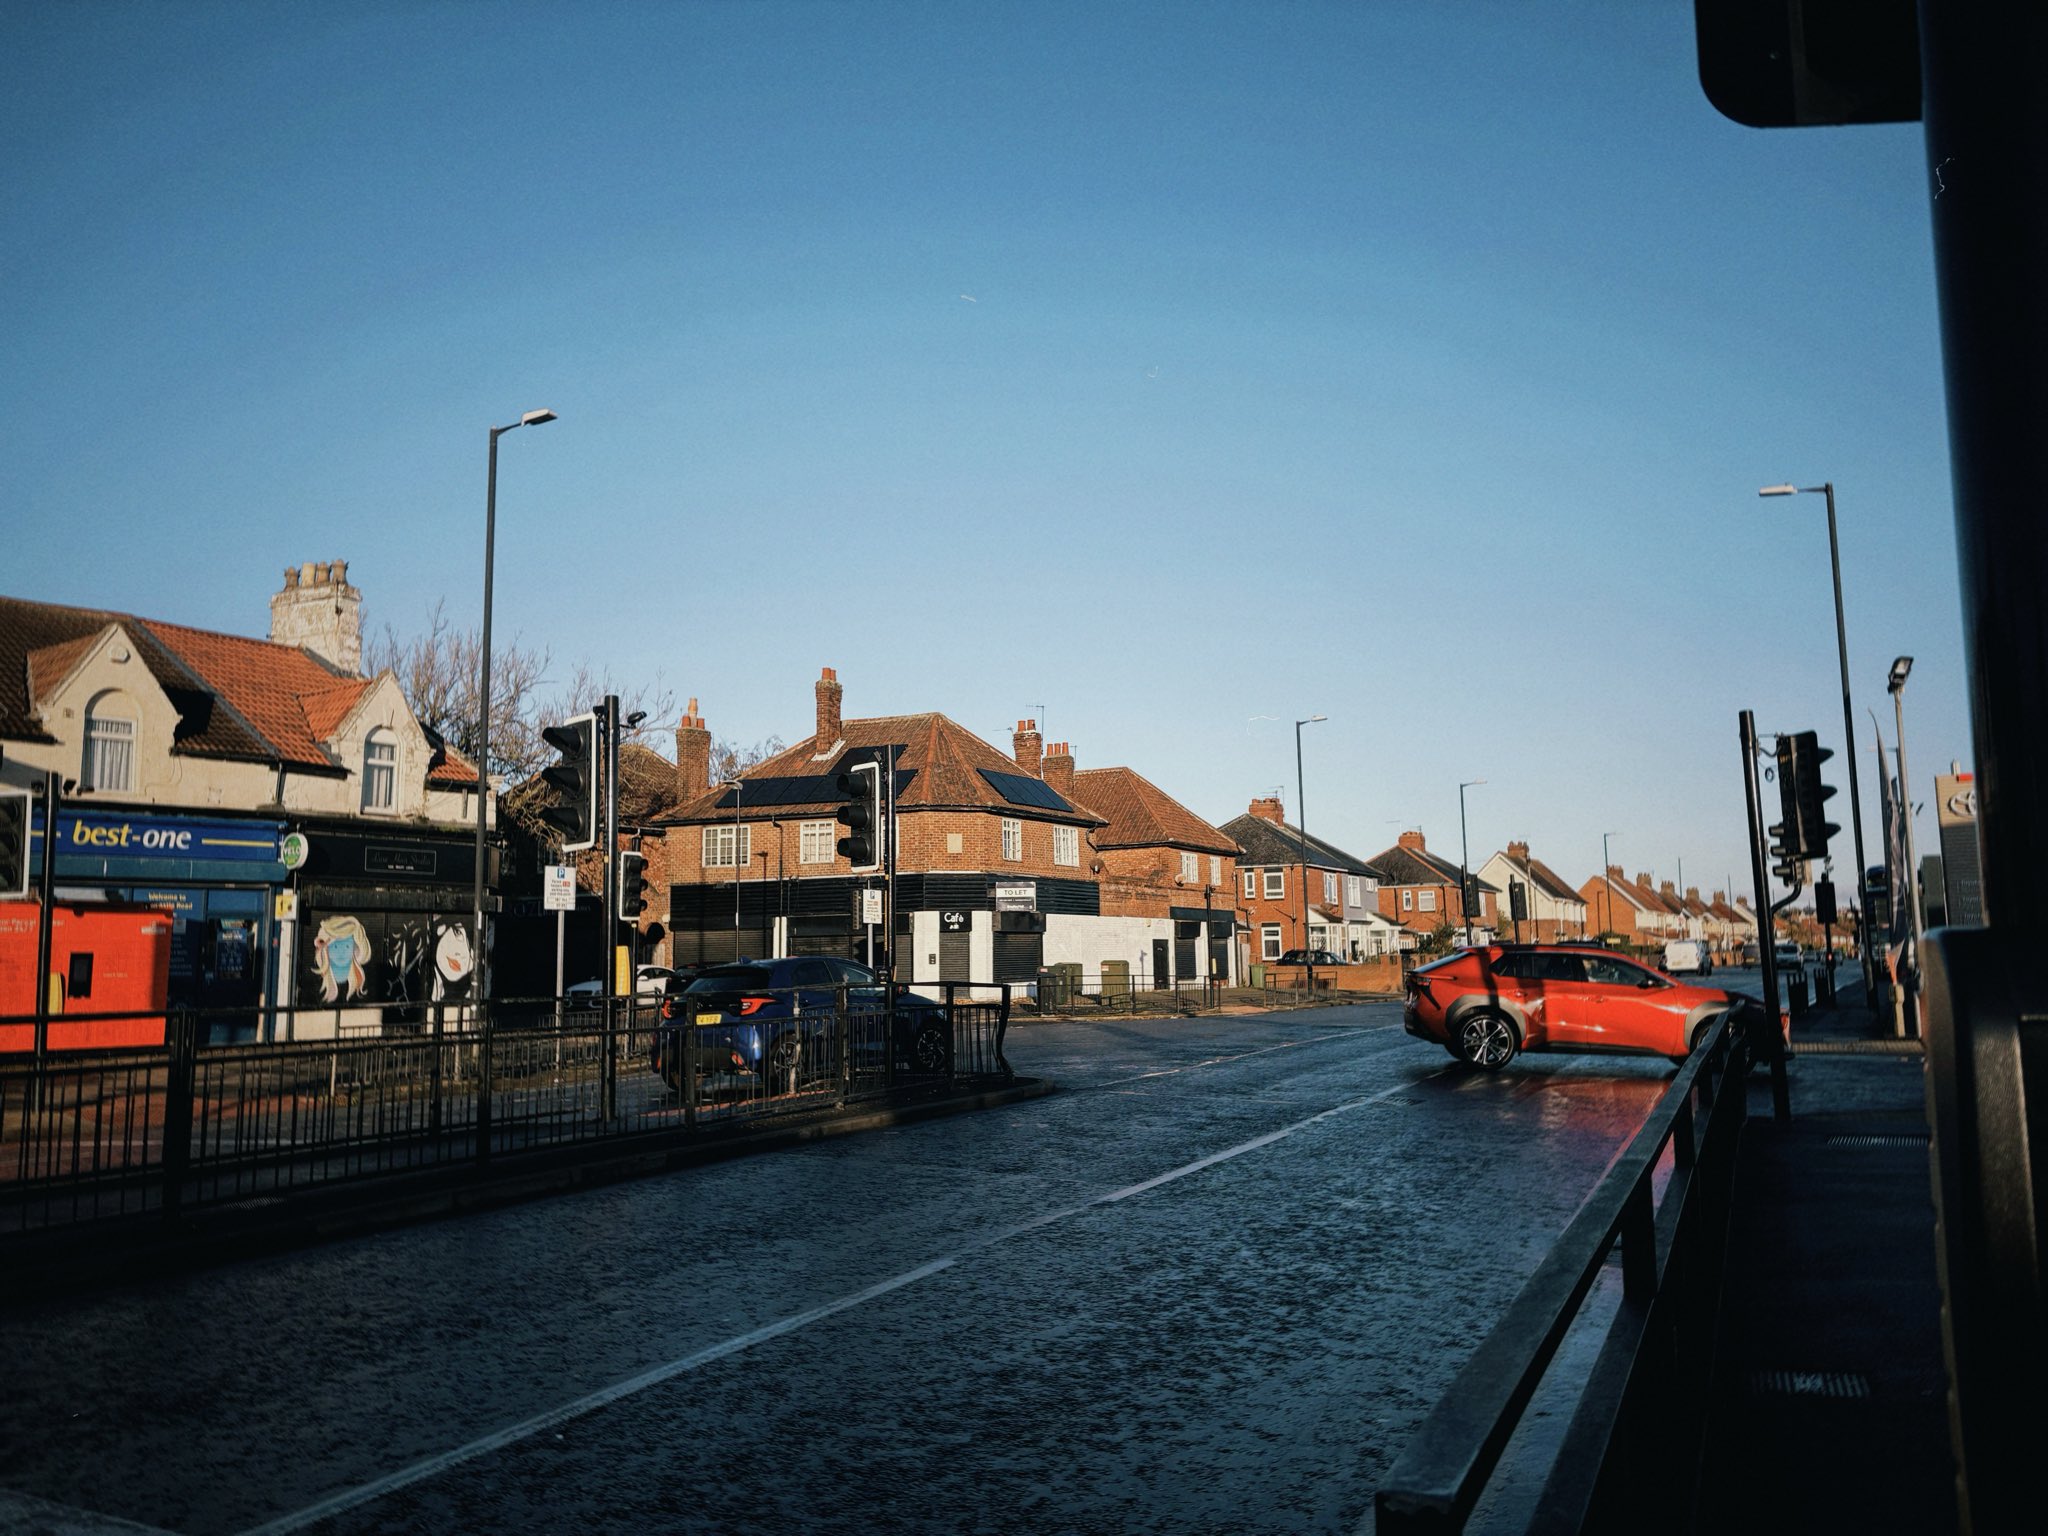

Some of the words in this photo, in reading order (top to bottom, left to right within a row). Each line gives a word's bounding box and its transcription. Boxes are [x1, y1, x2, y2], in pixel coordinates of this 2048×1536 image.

[73, 819, 192, 850] best-one
[148, 891, 177, 901] Welcome
[179, 893, 187, 902] to
